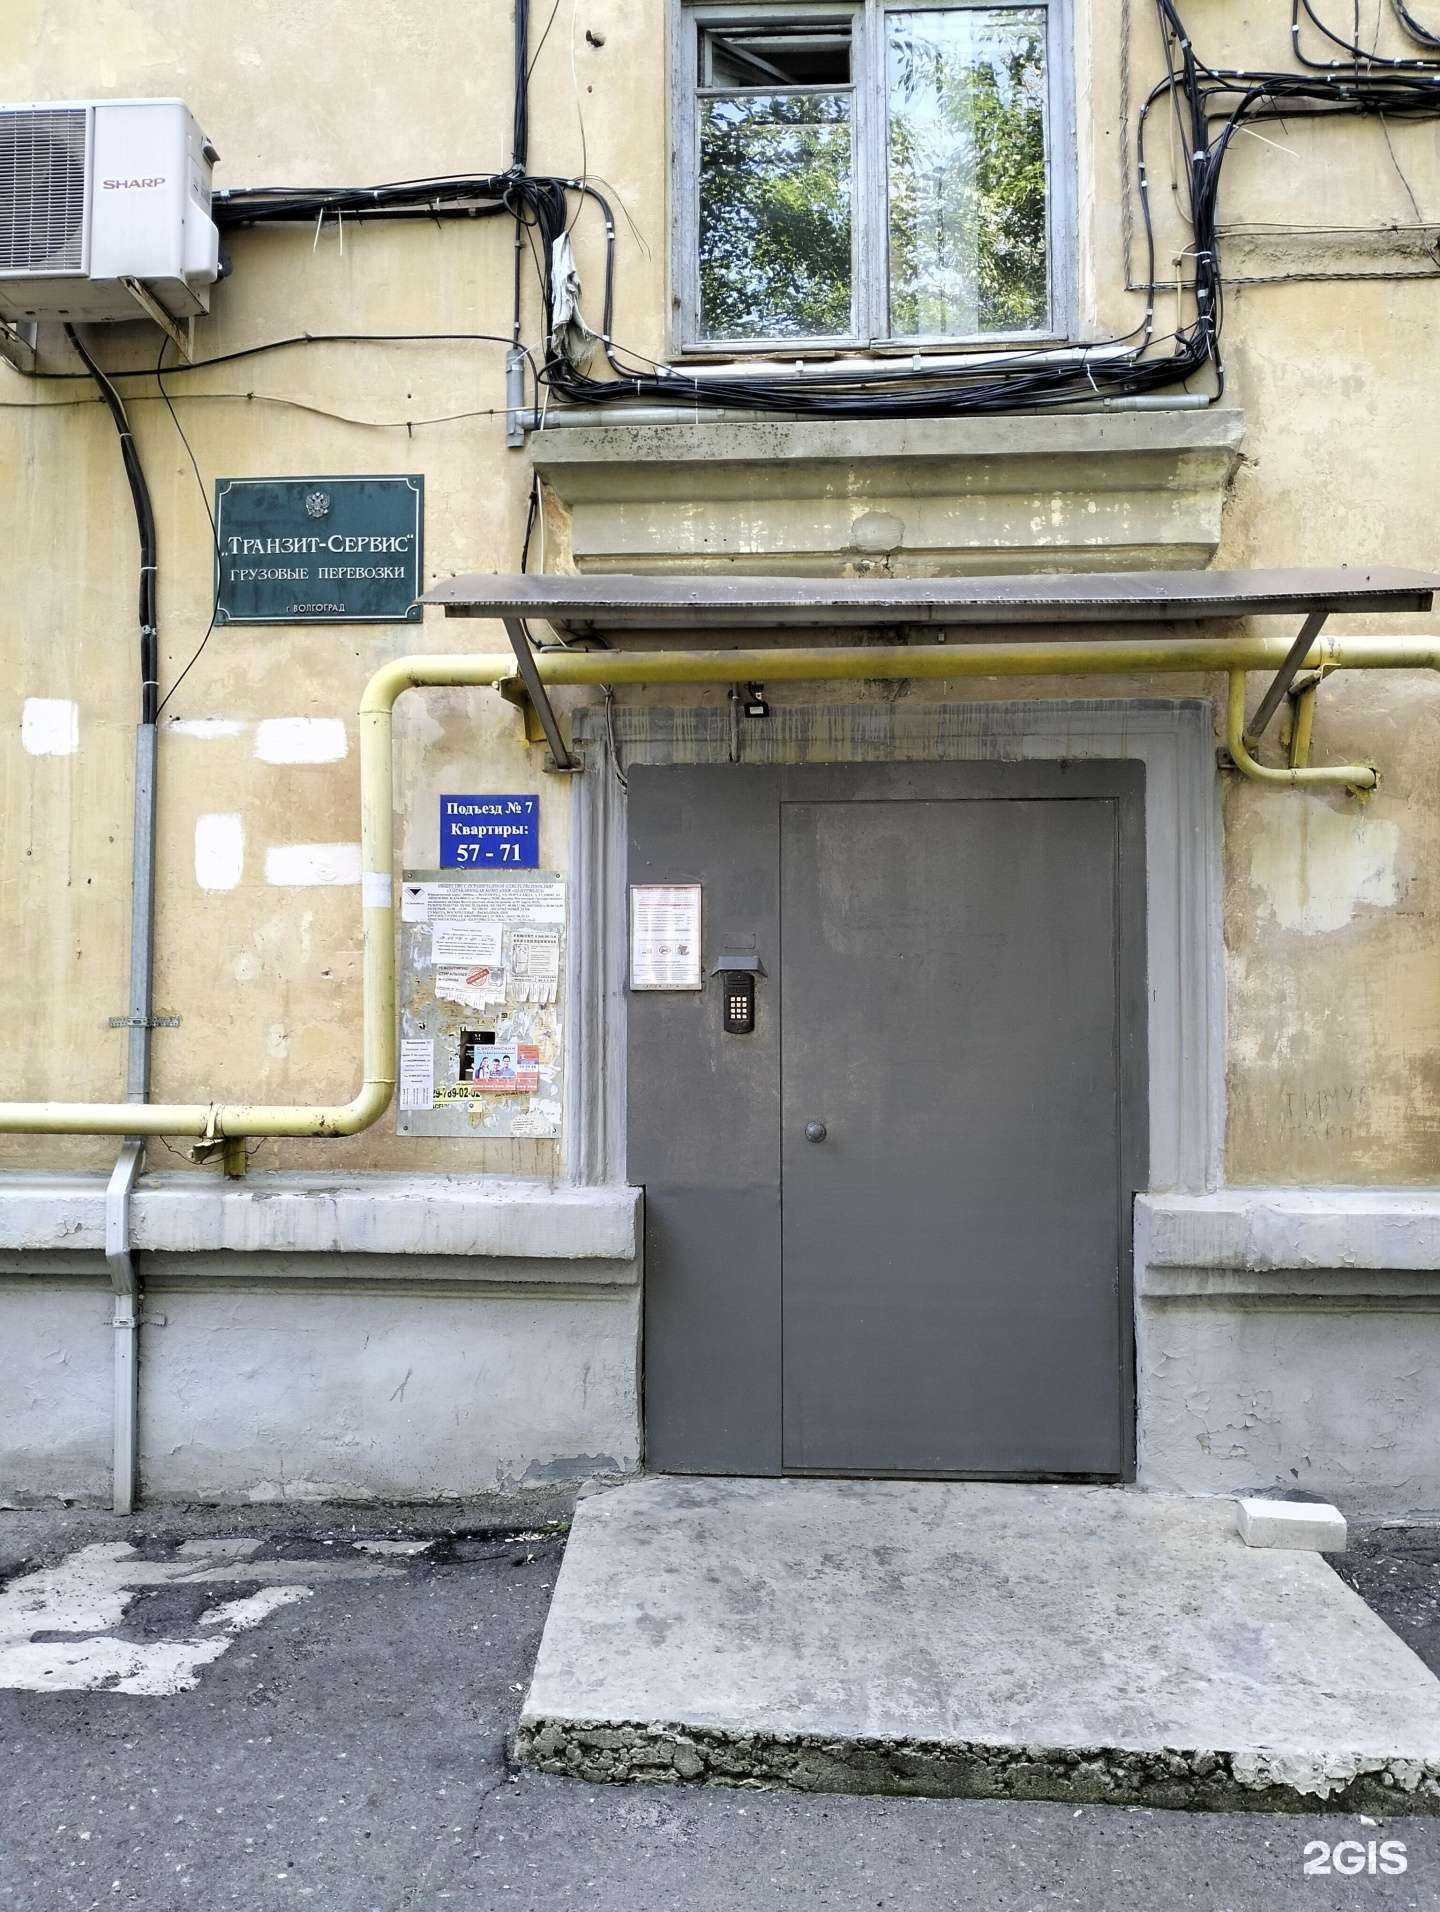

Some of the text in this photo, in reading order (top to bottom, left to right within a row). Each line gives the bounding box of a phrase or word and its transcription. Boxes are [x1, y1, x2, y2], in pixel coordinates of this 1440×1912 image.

[103, 177, 166, 190] SHARP
[230, 566, 405, 582] ГРУЗОВЫЕ ПЕРЕВОЗКИ
[293, 603, 345, 613] ВОЛГОГРАД
[447, 801, 533, 815] Подъезд № 7
[451, 822, 529, 838] Квартиры:
[456, 843, 481, 862] 57
[499, 843, 521, 862] 71
